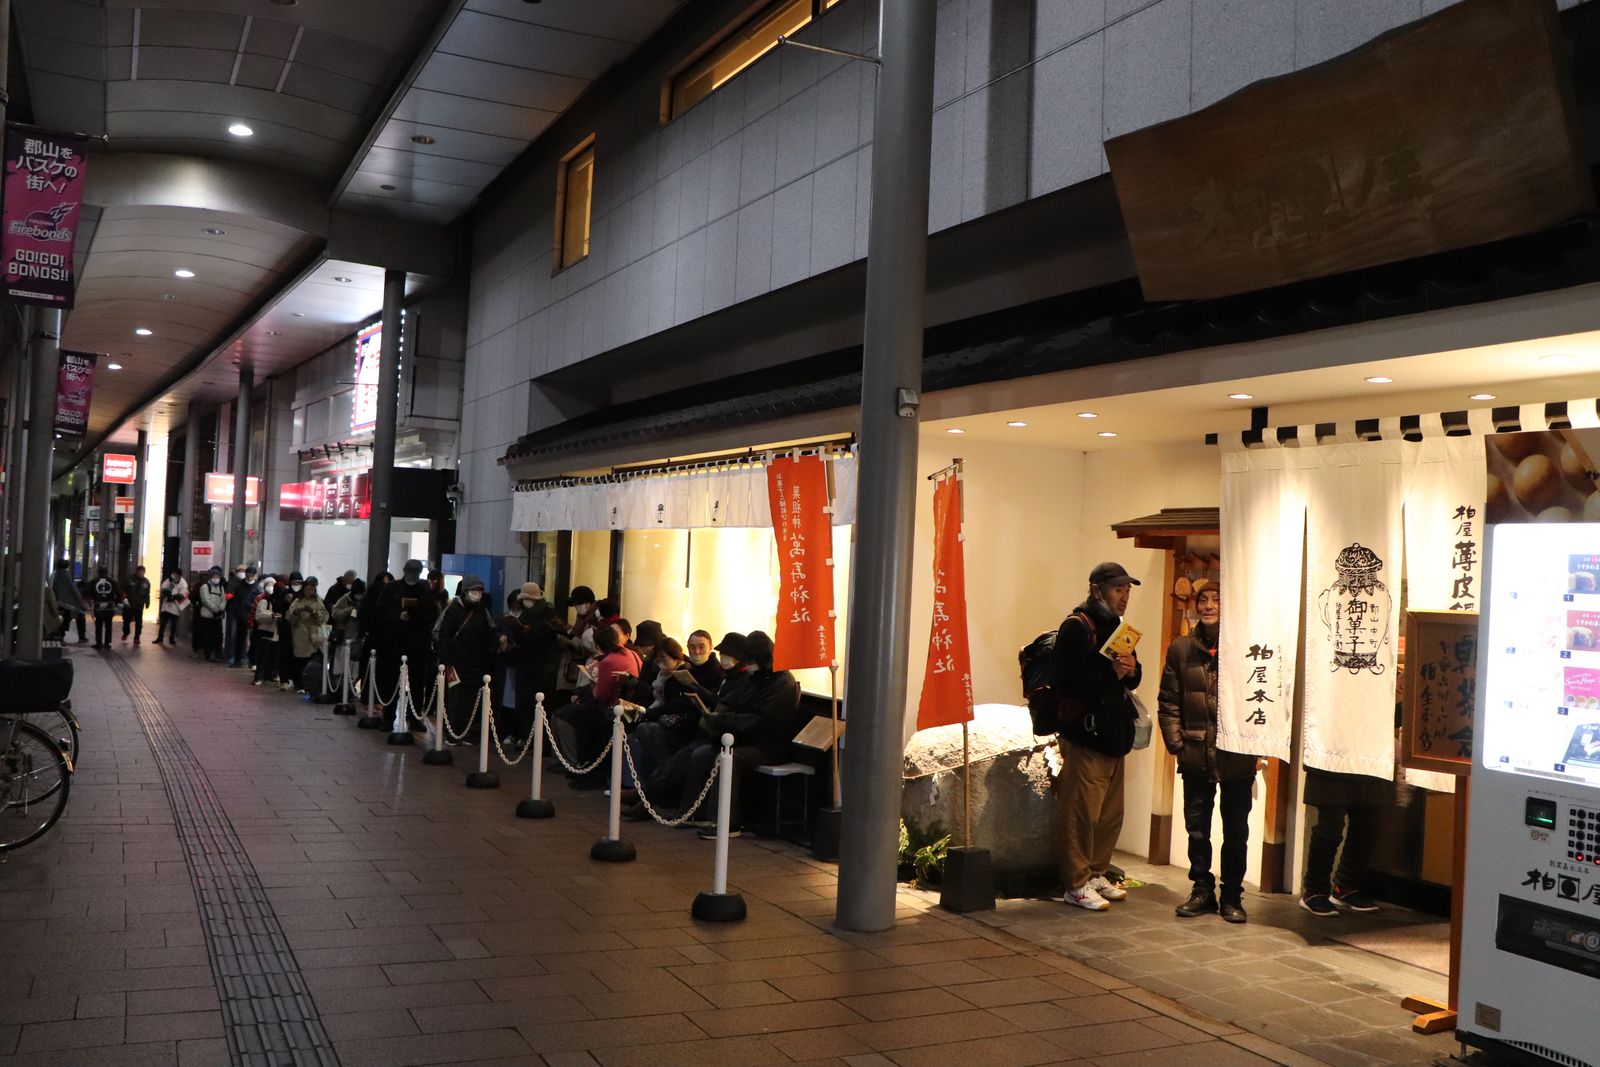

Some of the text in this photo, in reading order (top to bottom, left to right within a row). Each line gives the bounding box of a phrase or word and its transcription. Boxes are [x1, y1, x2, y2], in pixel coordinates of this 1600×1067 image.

[24, 138, 73, 159] 郡山を
[15, 155, 78, 178] バスケの
[9, 221, 73, 242] Firebonds
[1344, 597, 1368, 653] 御菓子
[1245, 643, 1275, 726] 柏屋本店
